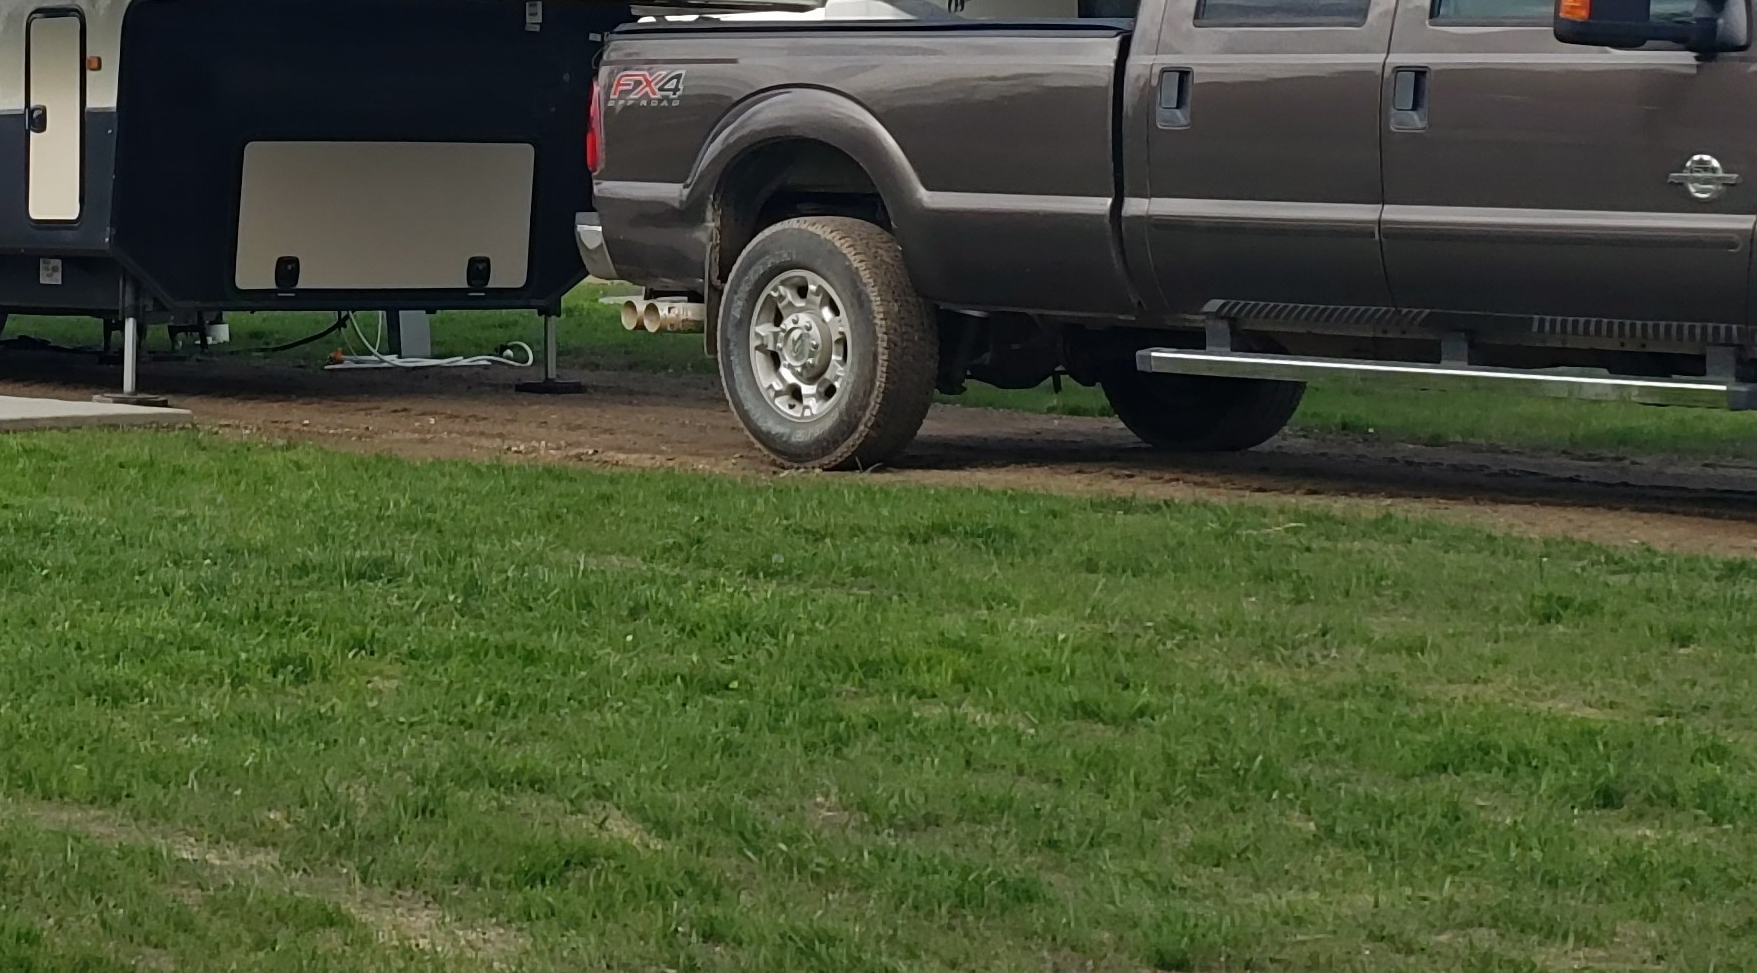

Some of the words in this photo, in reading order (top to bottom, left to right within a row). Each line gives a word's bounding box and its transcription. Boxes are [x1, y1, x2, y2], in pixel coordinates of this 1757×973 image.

[609, 69, 687, 99] FX4
[607, 99, 637, 107] OFF
[639, 99, 680, 107] ROAD
